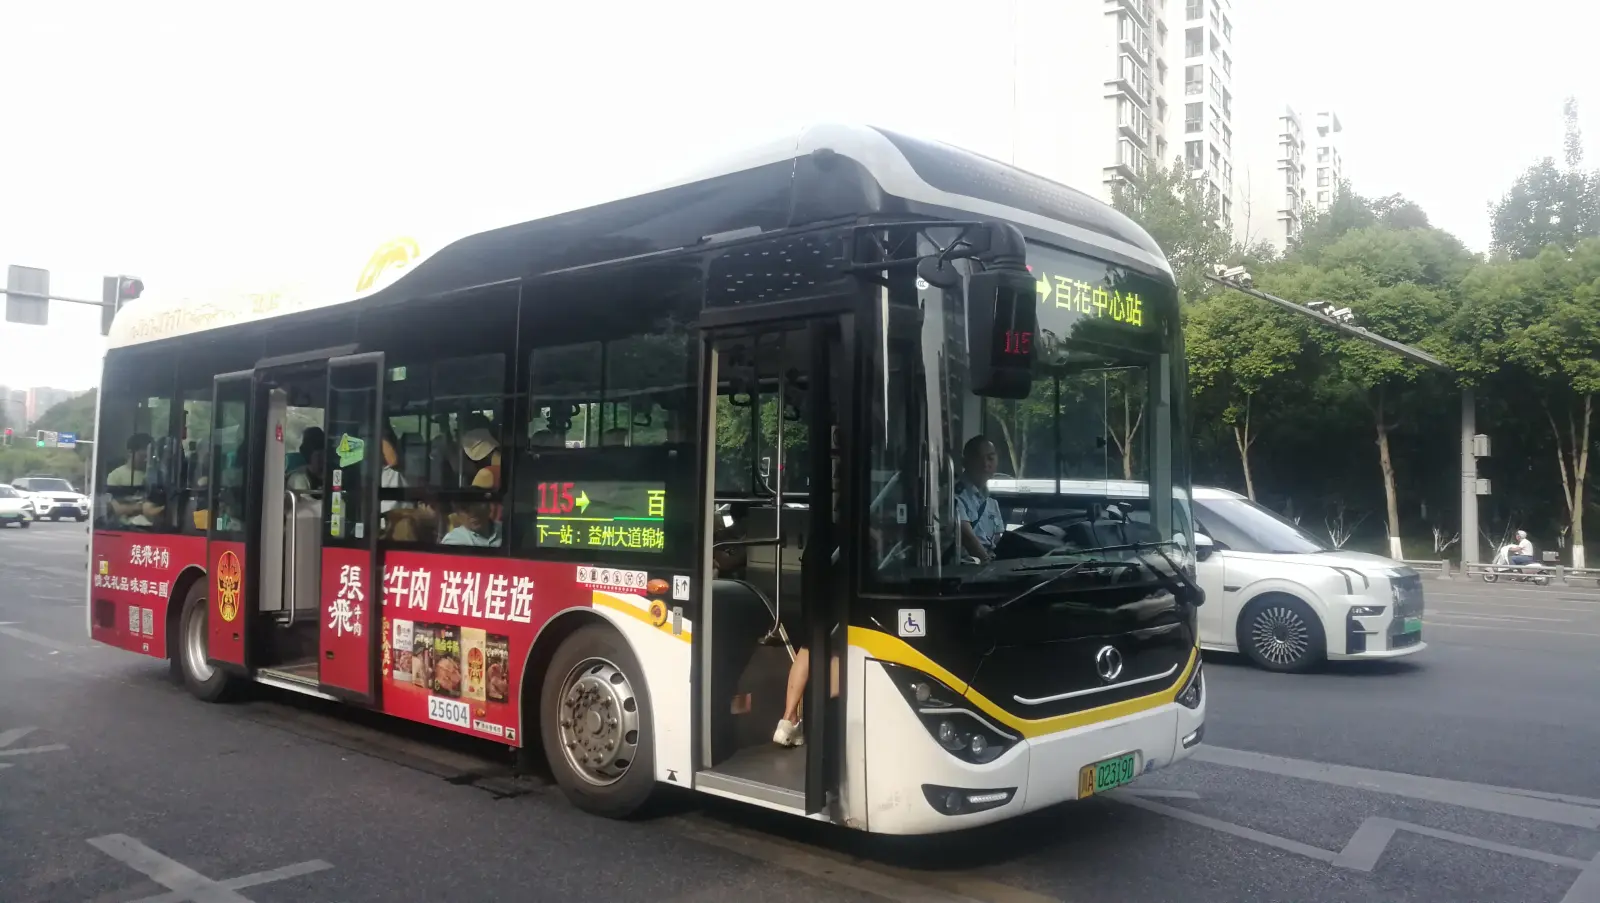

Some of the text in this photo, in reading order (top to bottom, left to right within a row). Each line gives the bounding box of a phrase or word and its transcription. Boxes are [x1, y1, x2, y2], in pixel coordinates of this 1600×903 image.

[1054, 275, 1142, 327] 百花中心站
[1004, 330, 1033, 354] 115
[537, 482, 665, 517] 115 百
[438, 570, 534, 623] 送礼佳选
[431, 699, 467, 724] 25604
